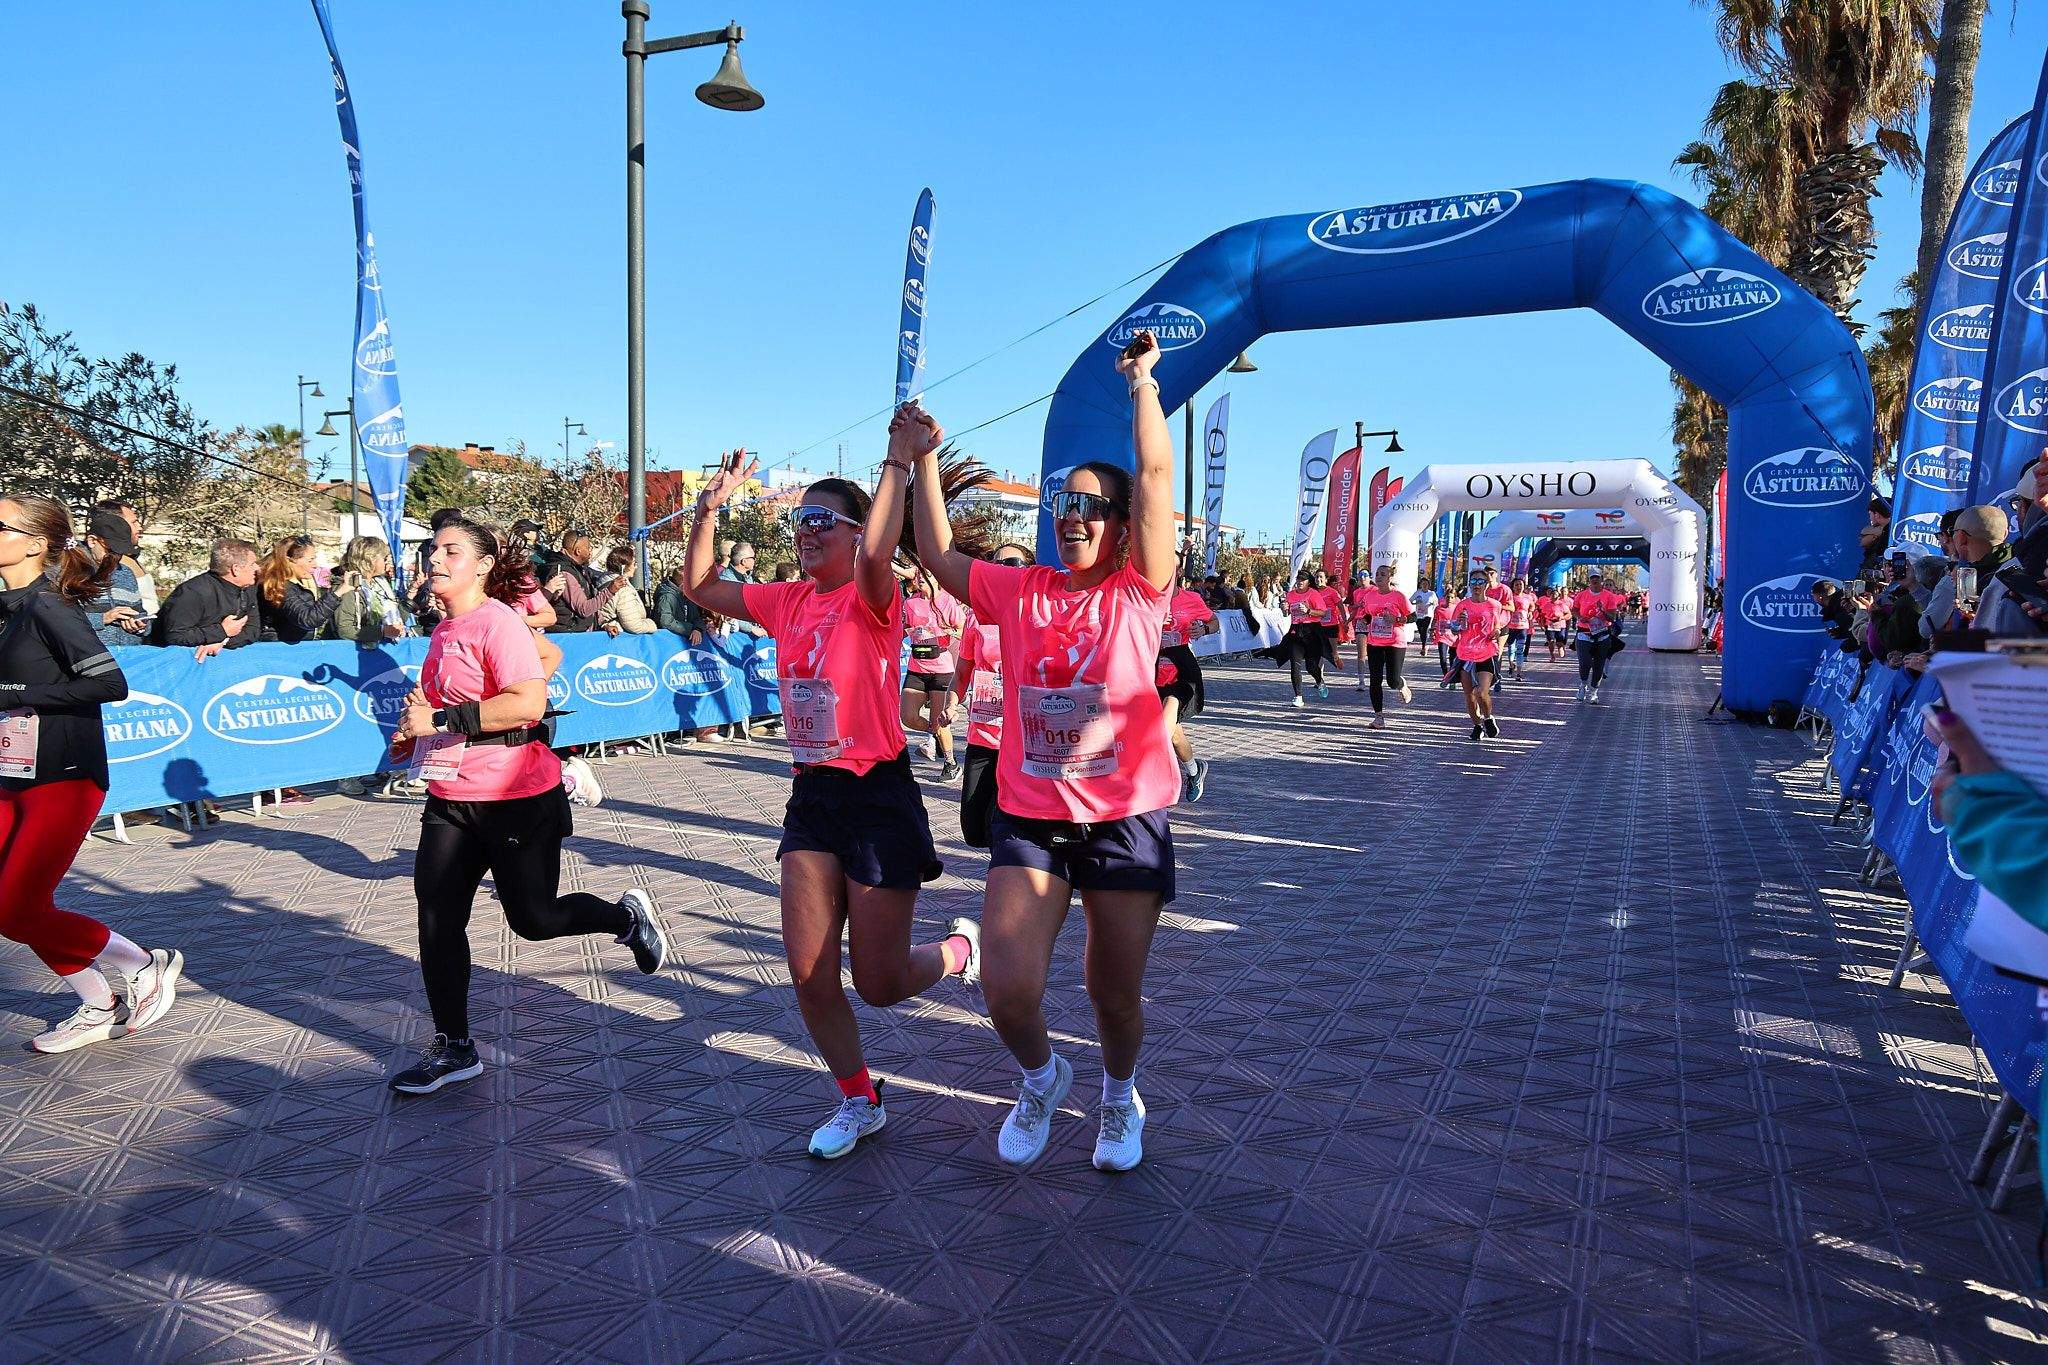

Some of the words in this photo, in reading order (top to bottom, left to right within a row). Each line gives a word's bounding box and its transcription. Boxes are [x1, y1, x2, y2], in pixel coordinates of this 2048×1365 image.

[1321, 197, 1504, 239] ASTURIANA
[1653, 290, 1773, 316] ASTURIANA
[1770, 468, 1815, 476] CENTRAL
[1466, 471, 1597, 498] OYSHO
[1751, 471, 1860, 494] ASTURIANA
[1336, 467, 1352, 533] Santander
[1392, 502, 1429, 511] OYSHO
[1635, 496, 1678, 506] OYSHO
[1374, 550, 1408, 559] OYSHO
[1655, 602, 1694, 612] OYSHO
[669, 666, 730, 687] ASTURIANA
[584, 675, 654, 695] ASTURIANA
[235, 698, 283, 709] CENTRAL
[285, 694, 329, 704] LECHERA
[117, 708, 172, 719] LECHERA
[217, 702, 338, 731] ASTURIANA
[105, 718, 181, 743] RIANA
[791, 716, 814, 730] 016
[1045, 728, 1081, 744] 016
[1074, 764, 1107, 774] Santander
